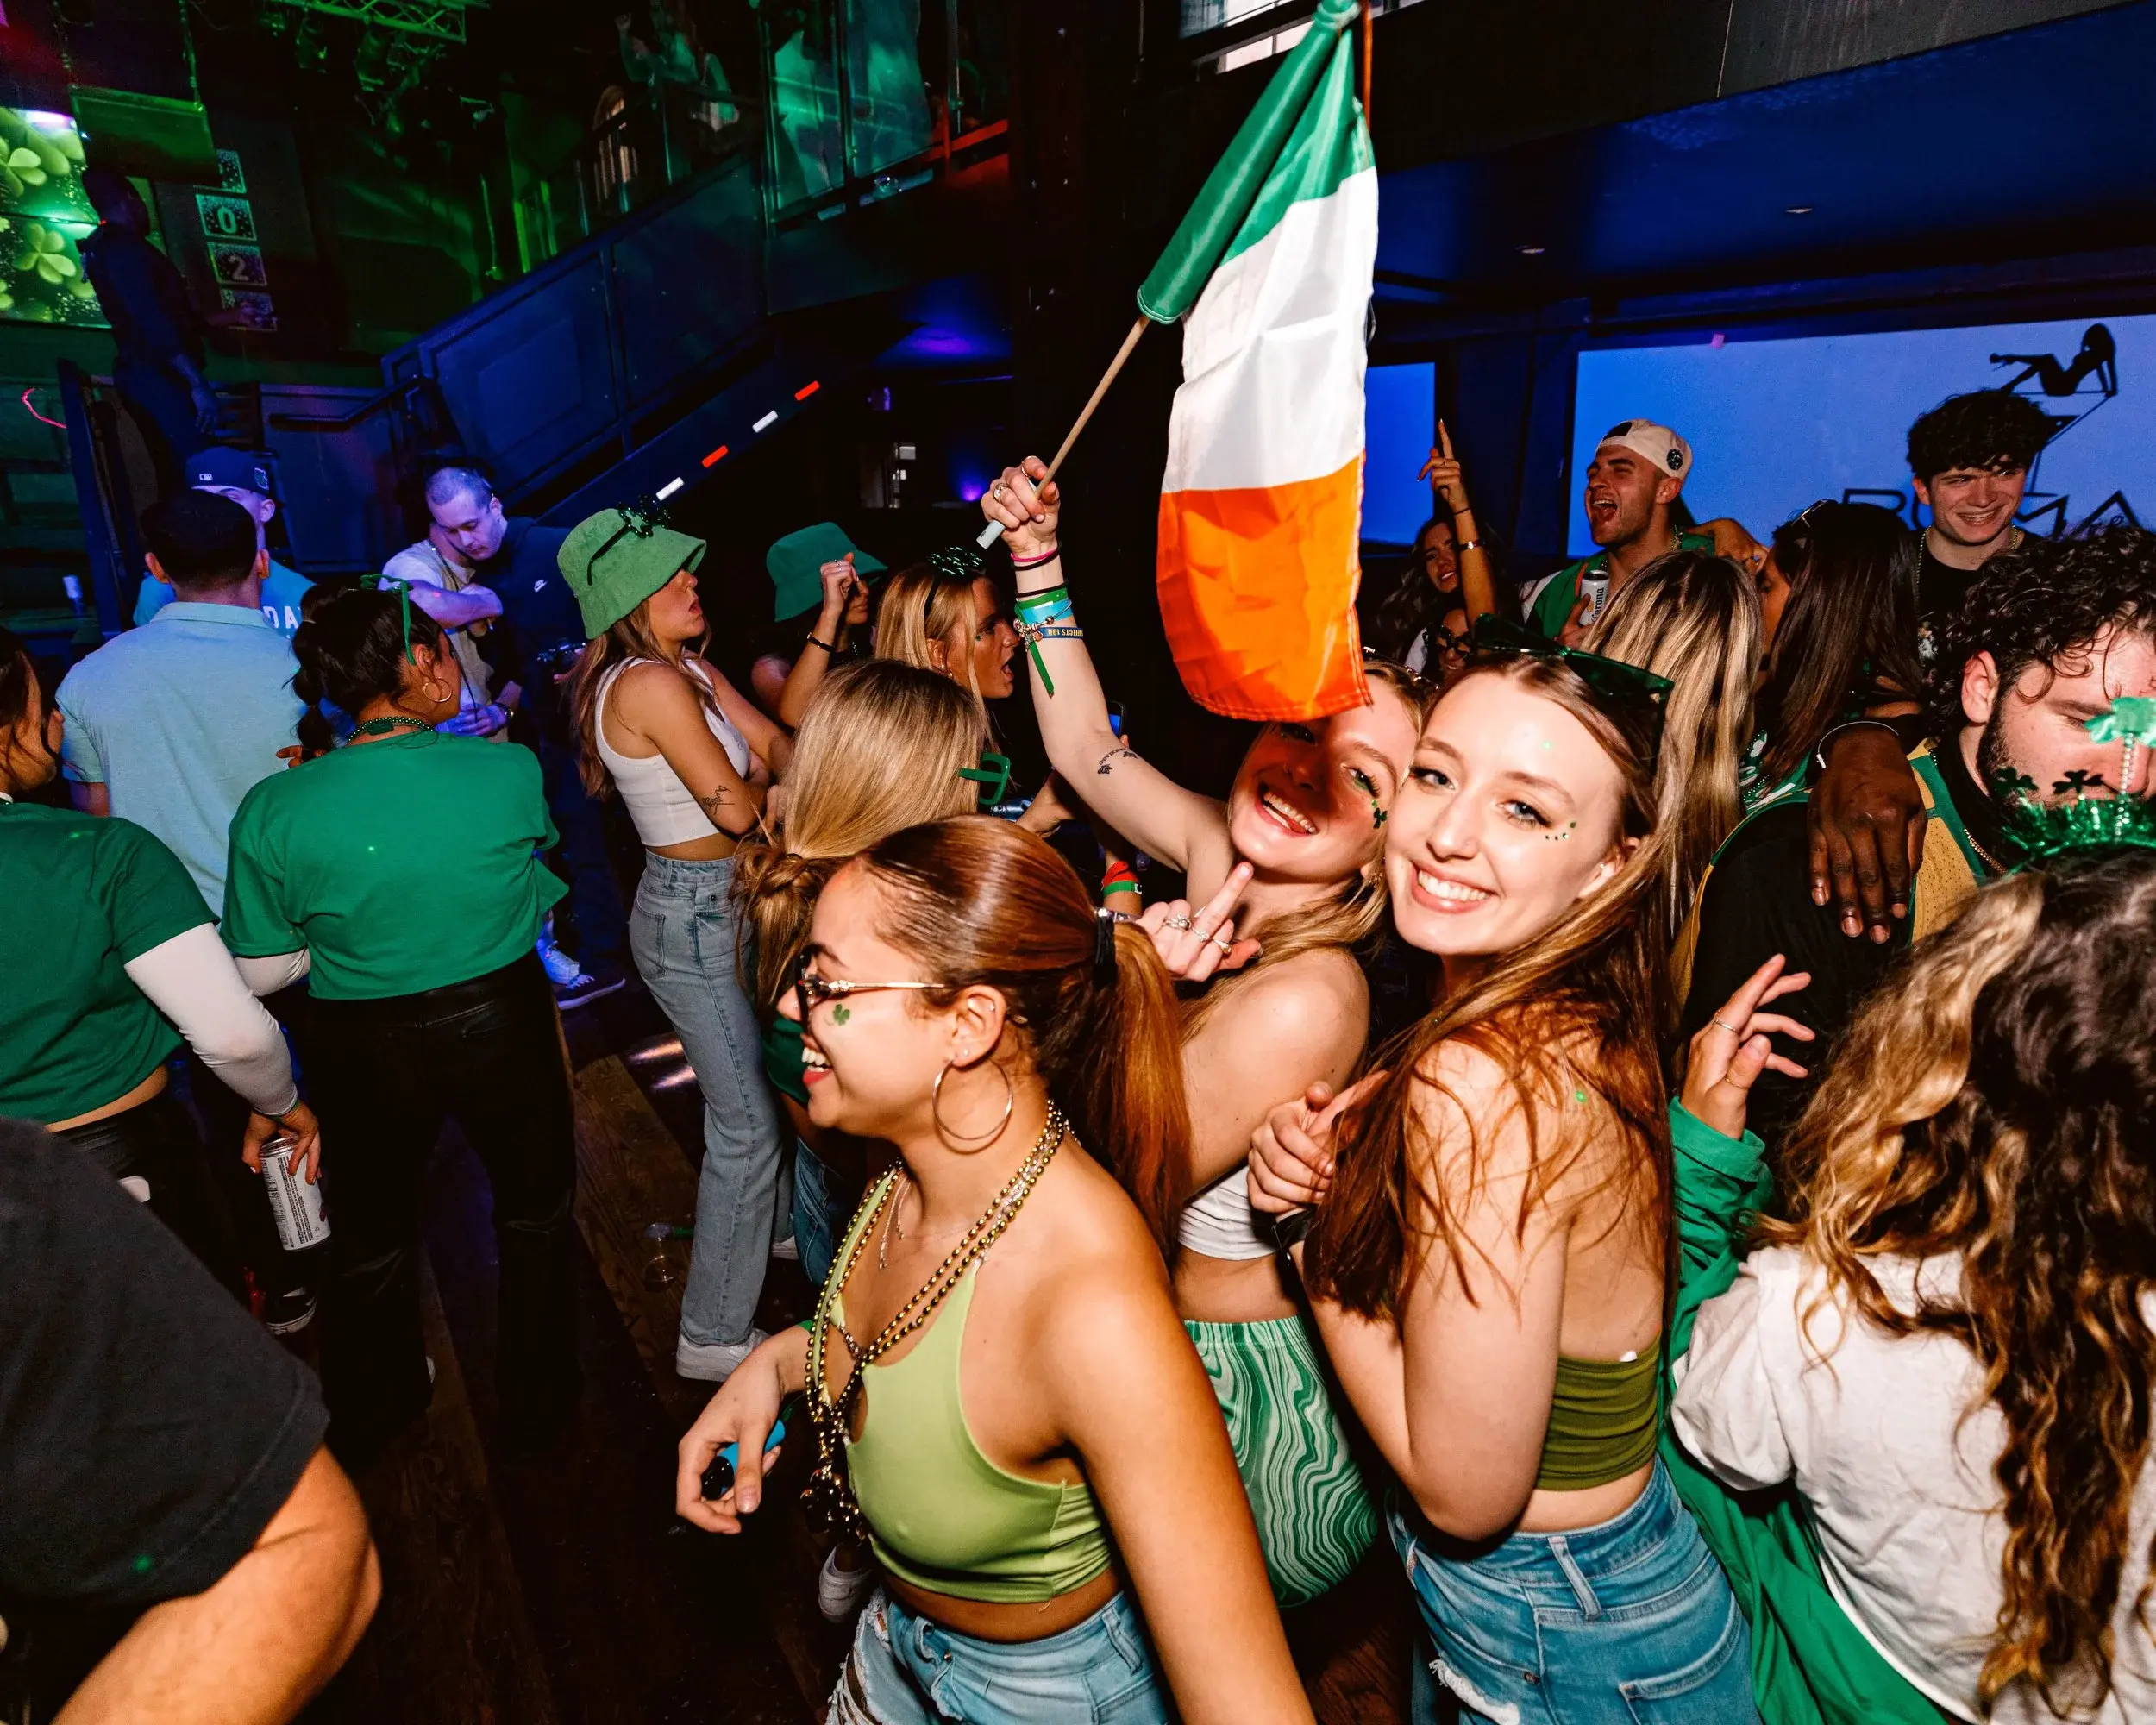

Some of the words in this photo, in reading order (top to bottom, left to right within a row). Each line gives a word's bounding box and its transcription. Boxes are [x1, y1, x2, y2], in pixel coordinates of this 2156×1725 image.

[217, 206, 237, 234] 0
[227, 255, 249, 281] 2
[262, 605, 301, 629] DA
[1590, 587, 1605, 622] Corona
